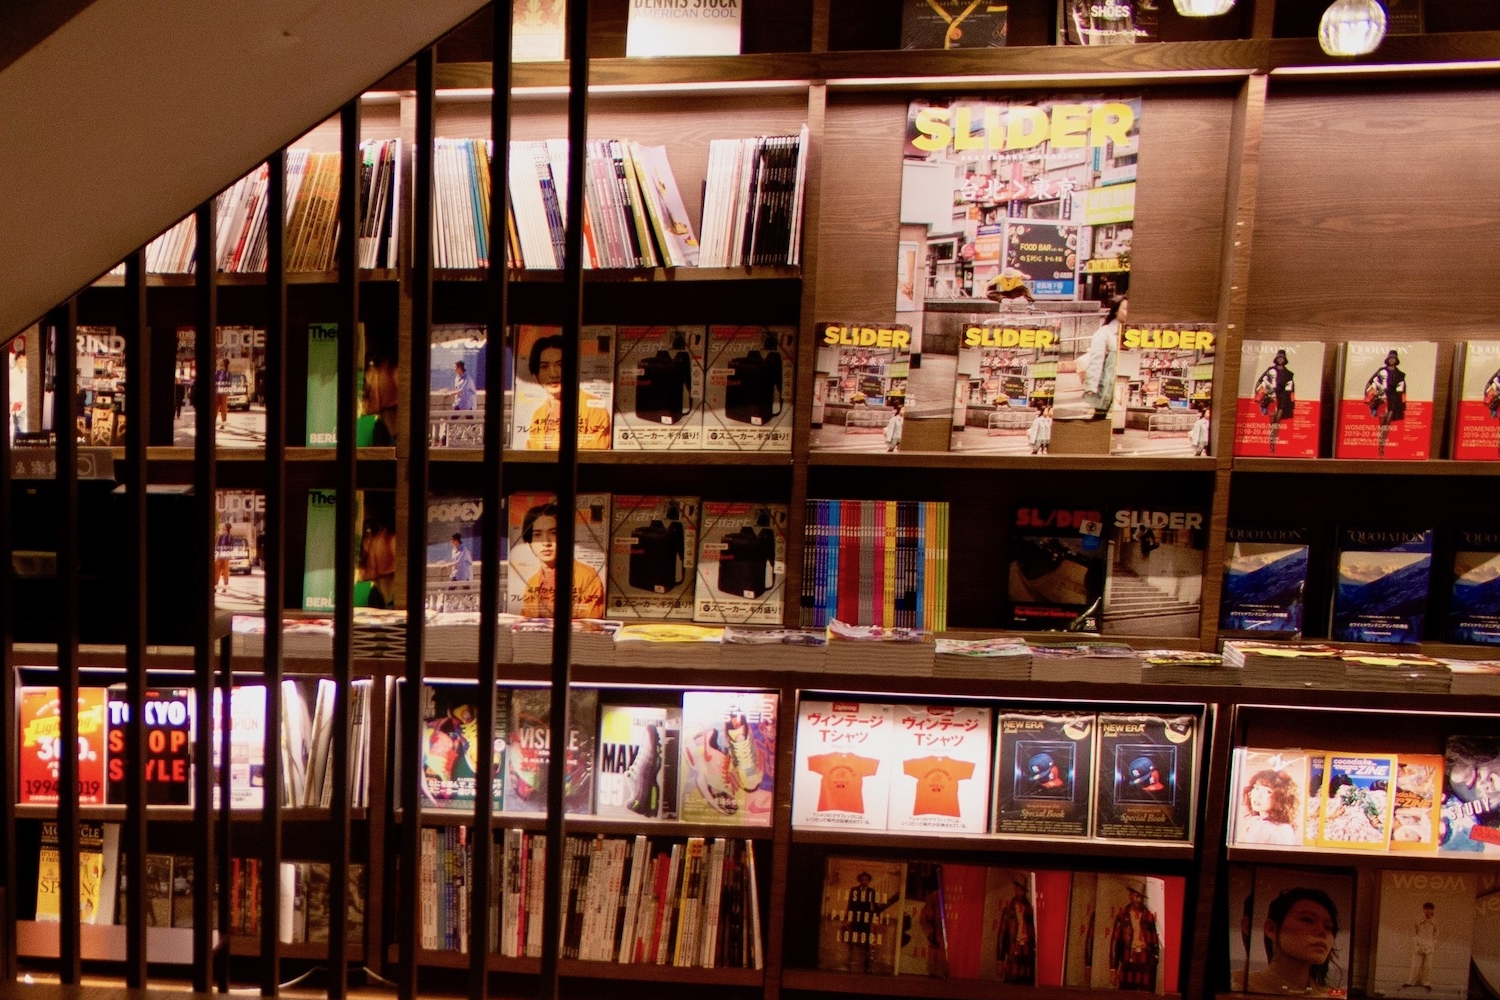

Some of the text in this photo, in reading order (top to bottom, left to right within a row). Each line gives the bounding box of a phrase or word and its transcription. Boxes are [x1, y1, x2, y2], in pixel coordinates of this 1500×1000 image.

[634, 8, 737, 18] AMERICAN COOL
[1091, 5, 1130, 17] SHOES
[911, 103, 1135, 151] SLIDER
[1038, 243, 1051, 251] BAR
[824, 326, 910, 348] SLIDER
[965, 327, 1053, 348] SLIDER
[1123, 329, 1214, 350] SLIDER
[1114, 509, 1204, 530] SLIDER
[807, 713, 884, 728] ヴィンテージ
[902, 716, 979, 732] ヴィンテージ
[1004, 720, 1044, 729] NEW ERA
[1103, 724, 1145, 732] NEW ERA
[108, 730, 185, 752] SOP
[819, 730, 869, 743] Tシャツ
[914, 733, 964, 747] Tシャツ
[601, 743, 640, 773] MAX
[108, 759, 185, 781] SYLE
[1020, 809, 1065, 818] Special Book
[1448, 797, 1491, 821] STUDY
[1120, 812, 1166, 822] Special Book
